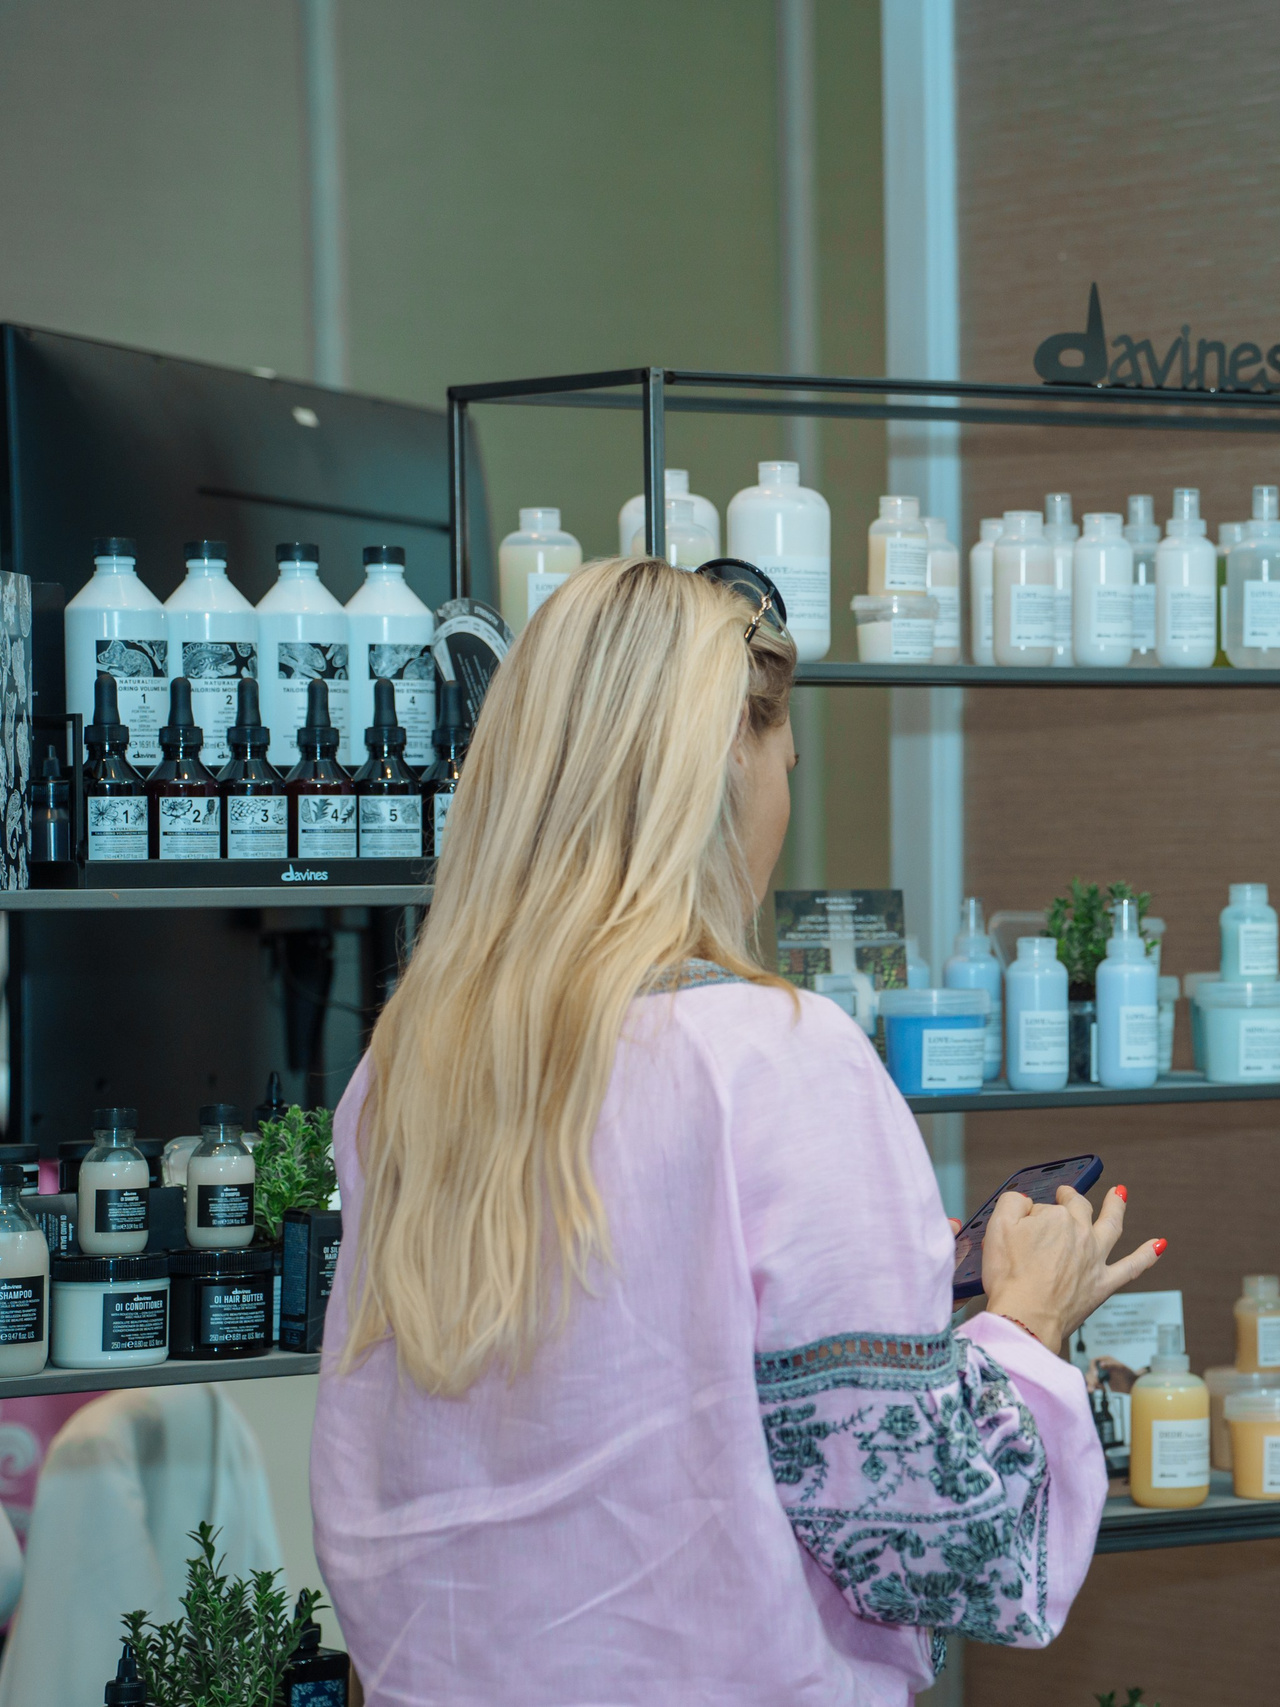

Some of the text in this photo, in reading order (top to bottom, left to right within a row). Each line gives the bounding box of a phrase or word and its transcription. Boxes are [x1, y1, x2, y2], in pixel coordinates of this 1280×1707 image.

[764, 567, 788, 575] LOVE
[141, 693, 146, 704] 1
[226, 695, 233, 705] 2
[409, 696, 416, 706] 4
[122, 810, 129, 823] 1
[192, 810, 201, 823] 2
[261, 809, 269, 823] 3
[331, 809, 339, 822] 4
[389, 809, 398, 822] 5
[281, 864, 328, 881] davines
[0, 1289, 33, 1300] SHAMPOO
[214, 1293, 263, 1304] OI HAIR BUTTER
[115, 1300, 163, 1311] OI CONDITIONER
[111, 1341, 120, 1349] 250
